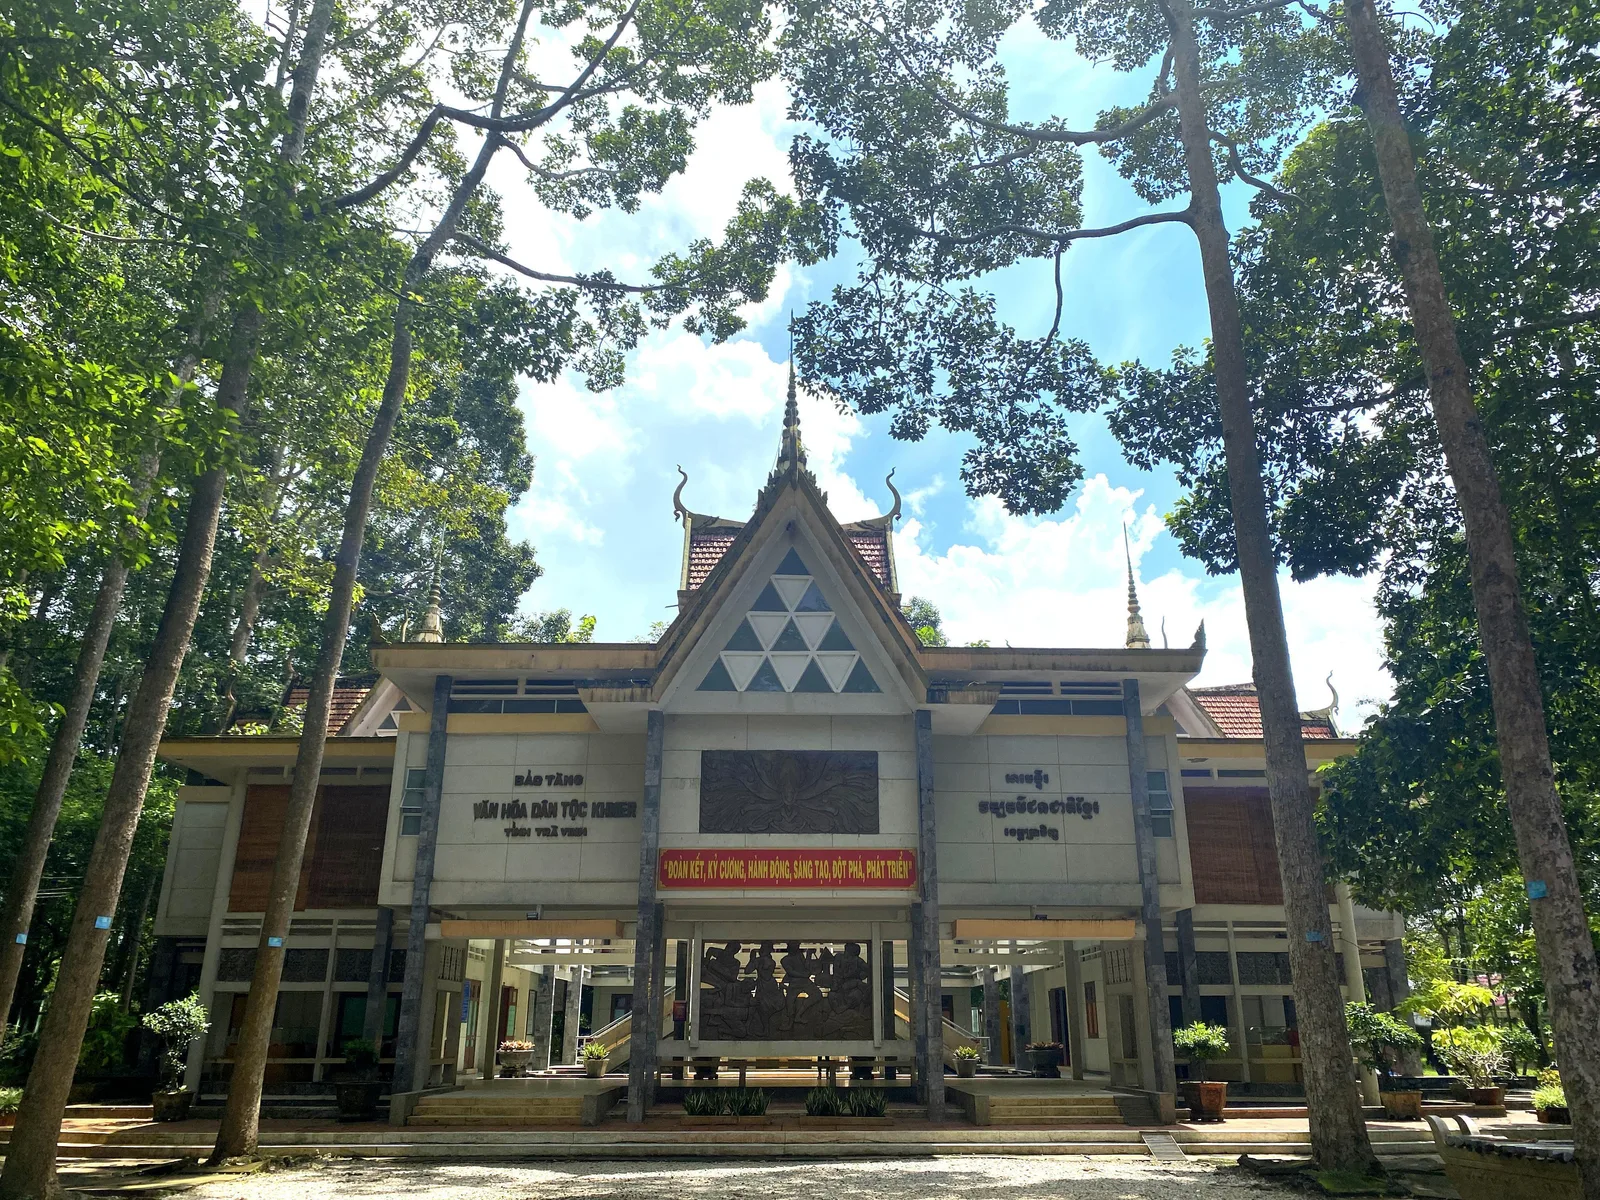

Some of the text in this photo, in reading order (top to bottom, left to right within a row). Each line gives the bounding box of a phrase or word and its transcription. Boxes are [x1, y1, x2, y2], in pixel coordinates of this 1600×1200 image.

[515, 769, 584, 786] BẢO TÀNG
[474, 799, 637, 821] VĂN HÓA DÂN TỘC KHMER
[504, 821, 588, 837] TỈNH TRÀ VINH
[690, 853, 706, 882] KẾT,
[708, 853, 718, 879] KỶ
[720, 856, 747, 883] CƯƠNG,
[748, 855, 769, 879] HÀNH
[770, 856, 792, 884] ĐỘNG,
[793, 855, 813, 879] SÁNG
[814, 860, 831, 884] TẠO,
[832, 856, 847, 884] ĐỘT
[848, 855, 865, 883] PHÁ,
[866, 855, 885, 879] PHÁT
